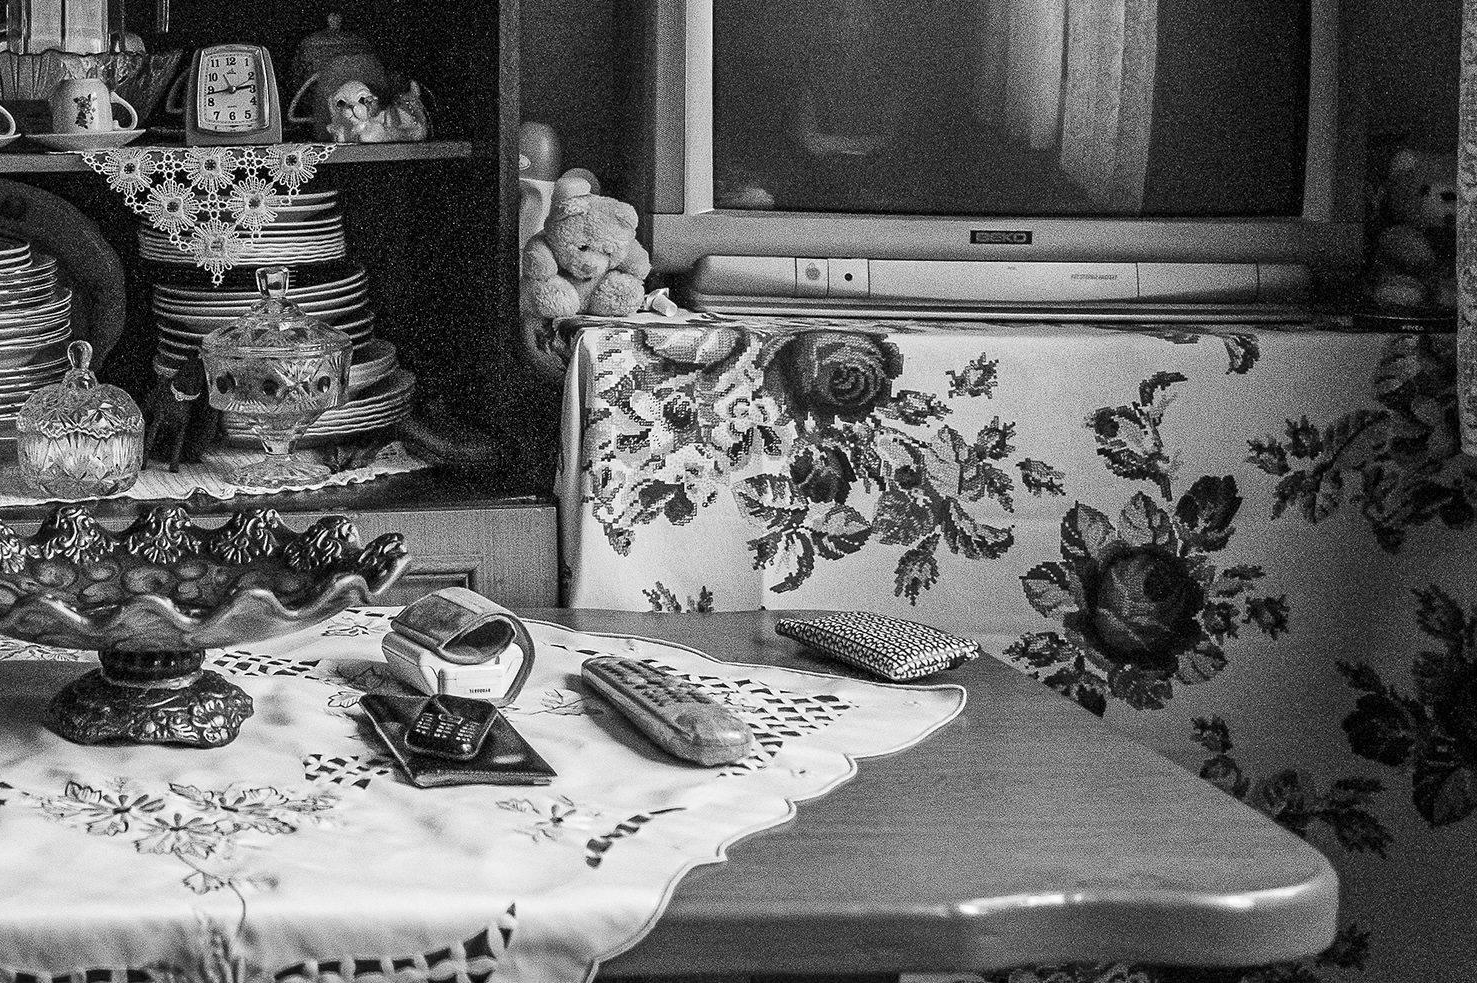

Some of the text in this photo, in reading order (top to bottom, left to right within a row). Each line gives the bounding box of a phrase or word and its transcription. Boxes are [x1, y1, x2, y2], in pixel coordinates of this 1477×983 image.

[211, 59, 220, 67] 11
[225, 57, 236, 66] 12
[244, 58, 249, 67] 1
[208, 73, 218, 82] 10
[248, 72, 254, 80] 2
[208, 86, 215, 94] 9
[249, 84, 256, 93] 3
[208, 98, 215, 107] 8
[250, 97, 257, 105] 4
[213, 111, 220, 120] 7
[229, 112, 235, 120] 6
[244, 110, 251, 119] 5
[975, 232, 1027, 243] BEKO
